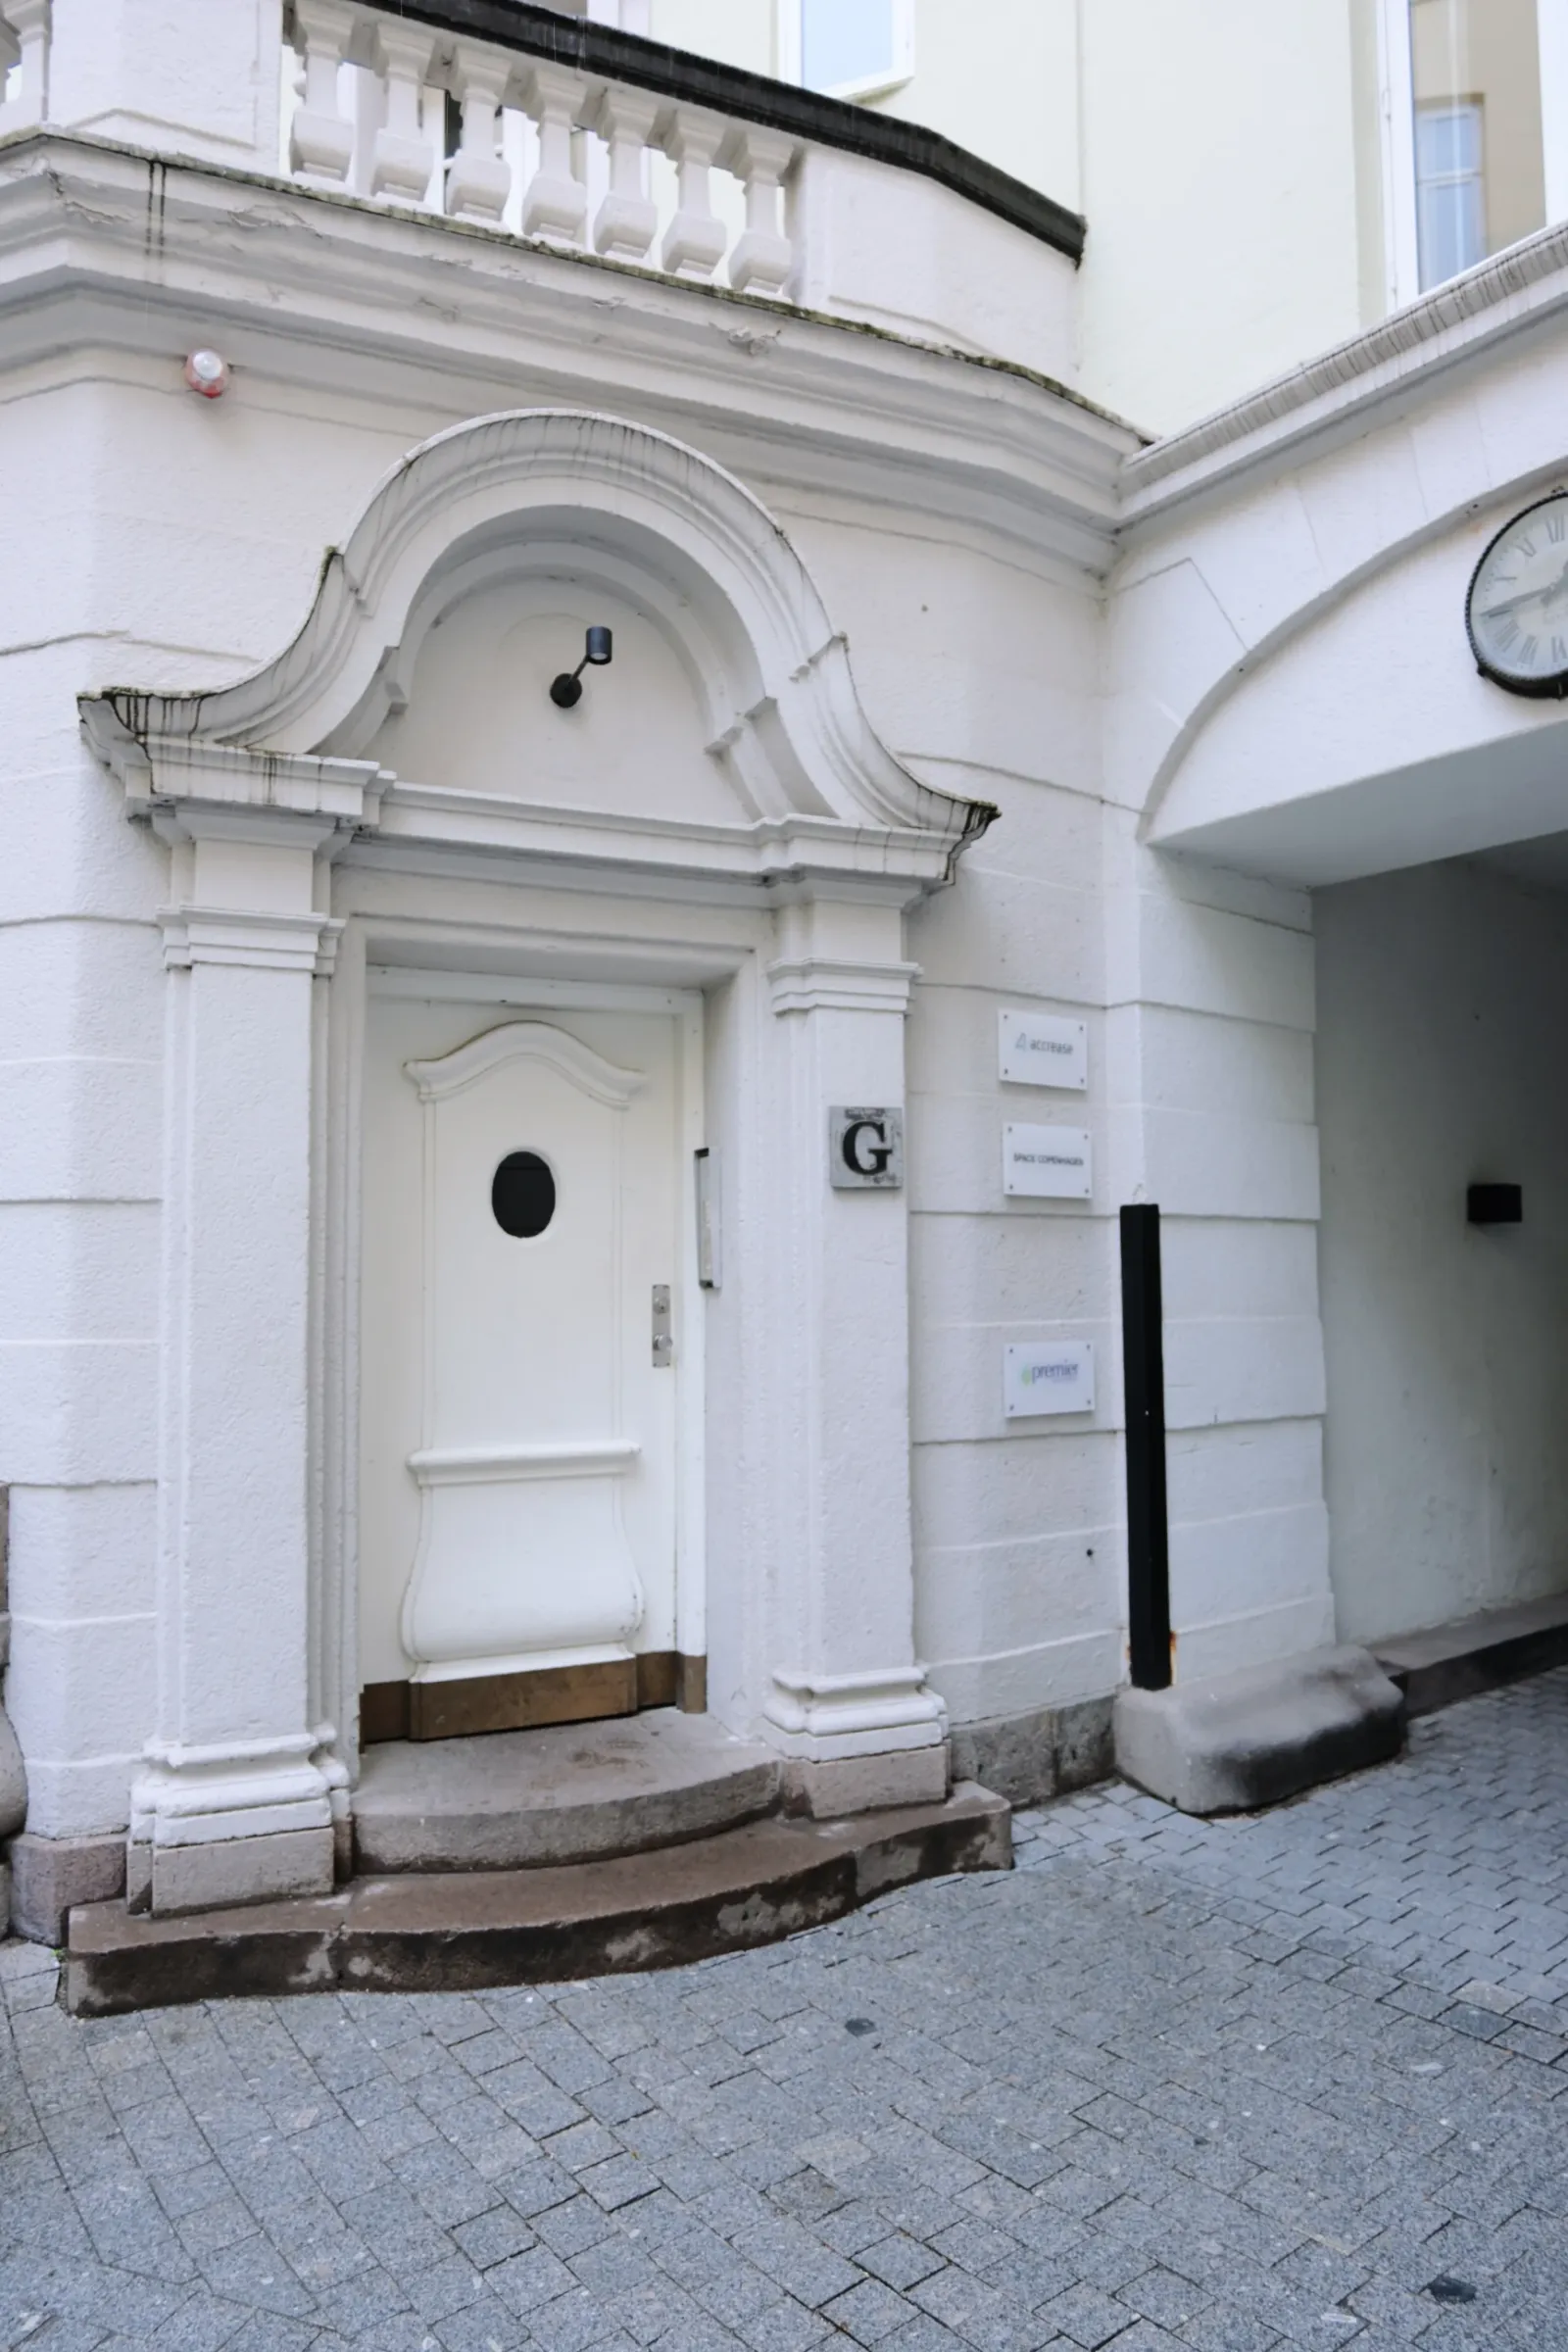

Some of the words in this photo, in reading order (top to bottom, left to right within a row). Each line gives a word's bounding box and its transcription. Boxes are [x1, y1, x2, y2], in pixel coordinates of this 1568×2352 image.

[843, 1120, 894, 1177] G
[1012, 1152, 1036, 1163] SPACE
[1031, 1358, 1079, 1384] premier
